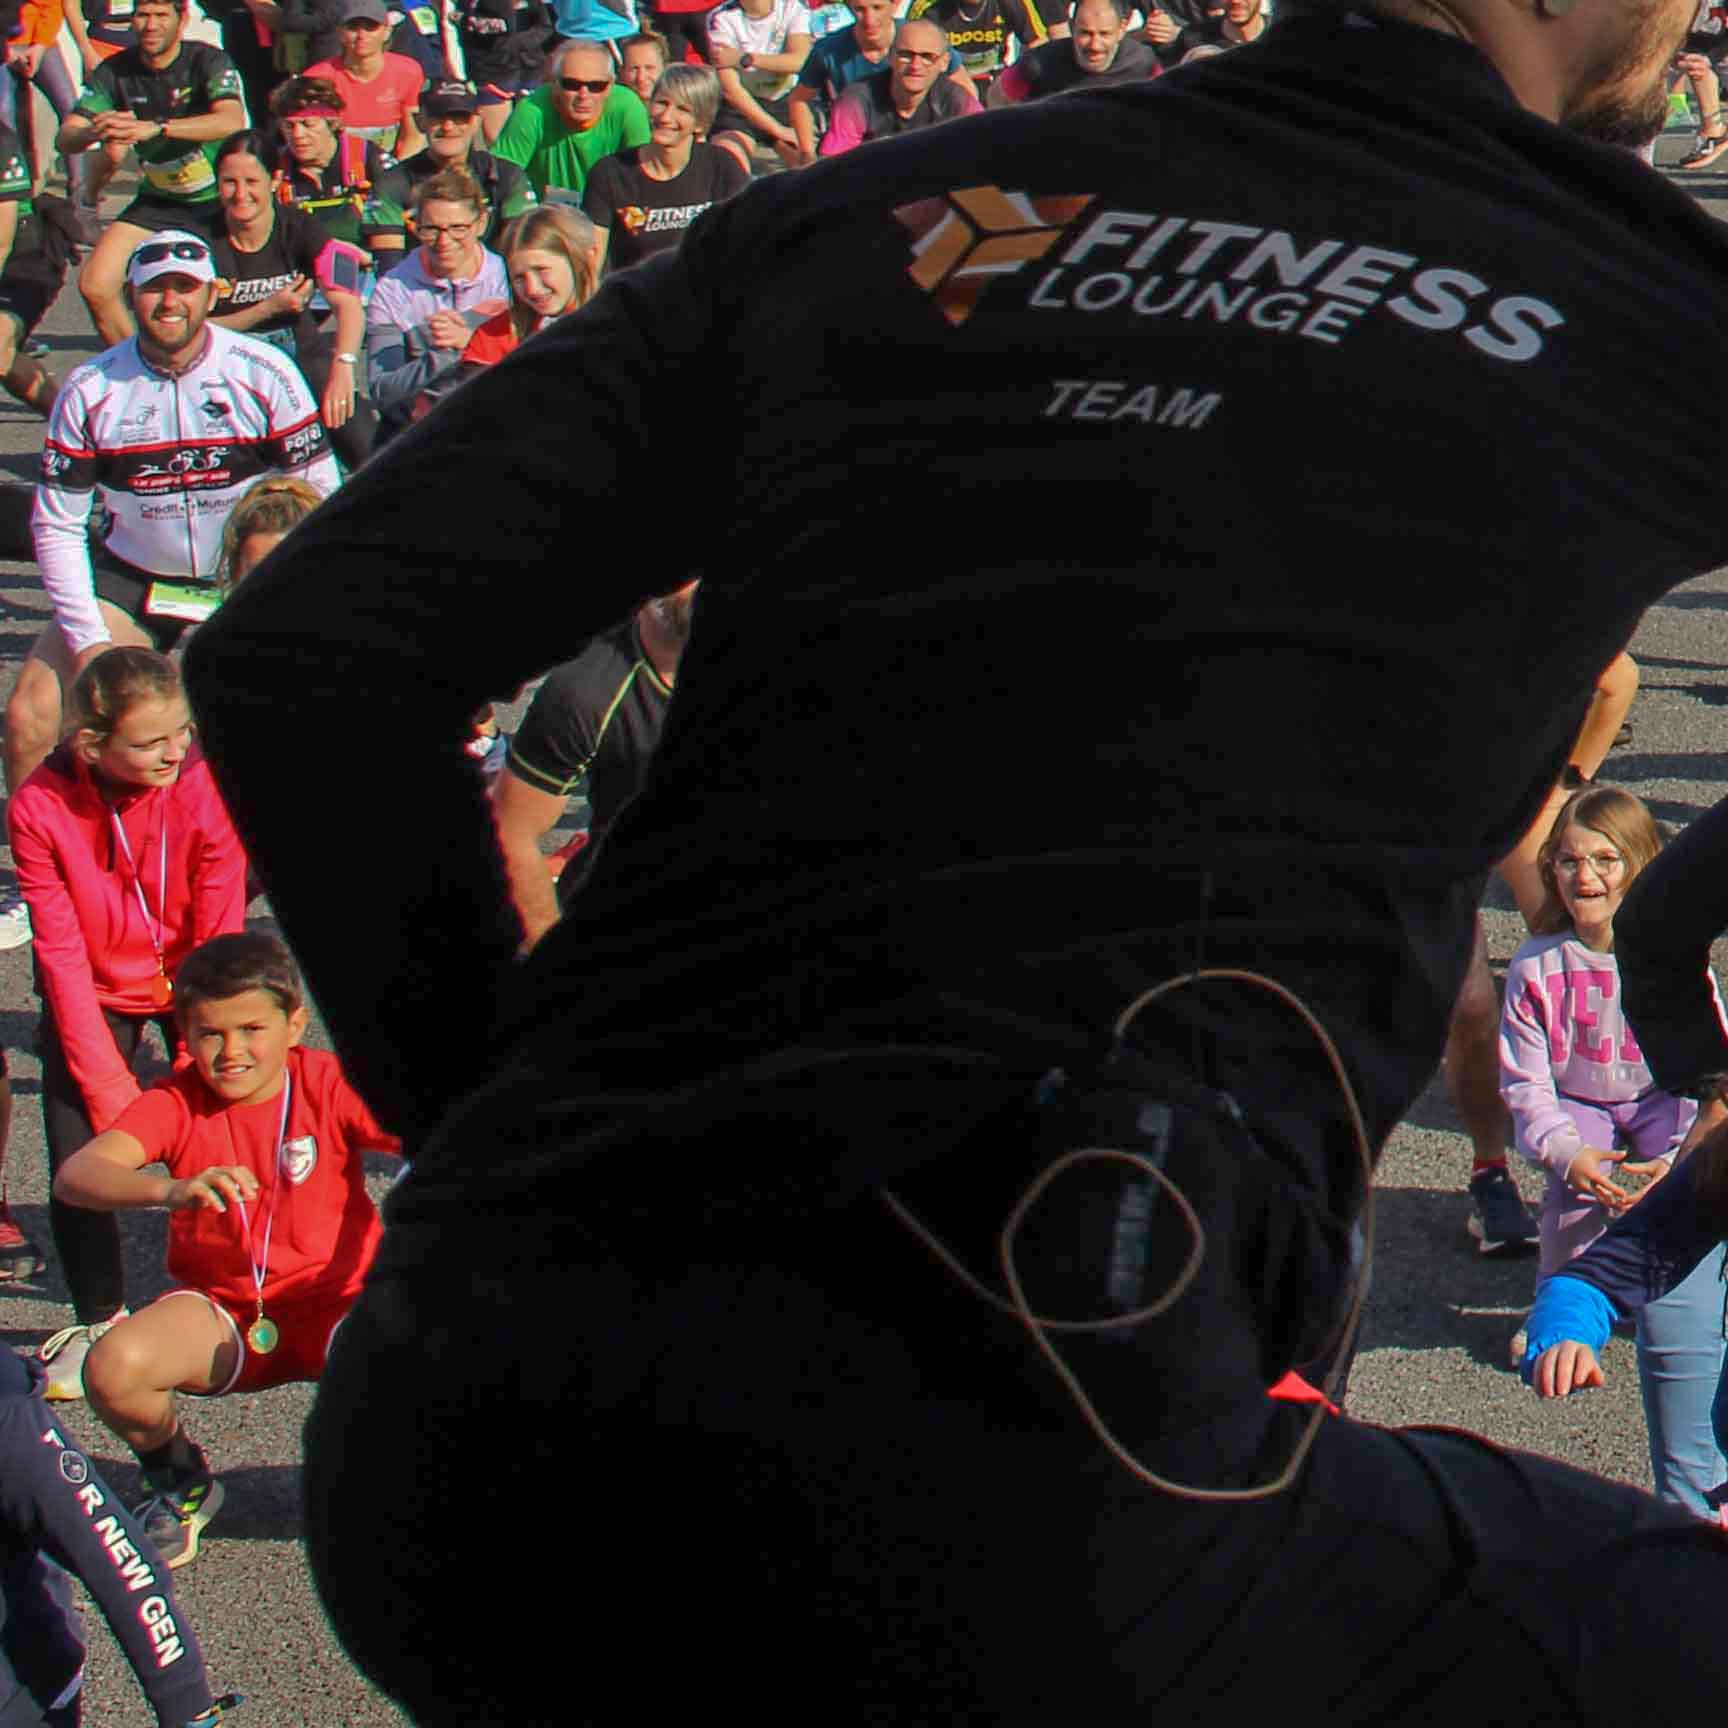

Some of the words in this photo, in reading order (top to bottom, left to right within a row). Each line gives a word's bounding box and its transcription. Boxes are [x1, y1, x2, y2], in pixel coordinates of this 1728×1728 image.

[1029, 266, 1372, 345] LOUNGE
[1060, 210, 1565, 363] FITNESS
[1041, 379, 1223, 430] TEAM
[93, 1514, 156, 1593] NEW
[137, 1594, 186, 1669] GEN
